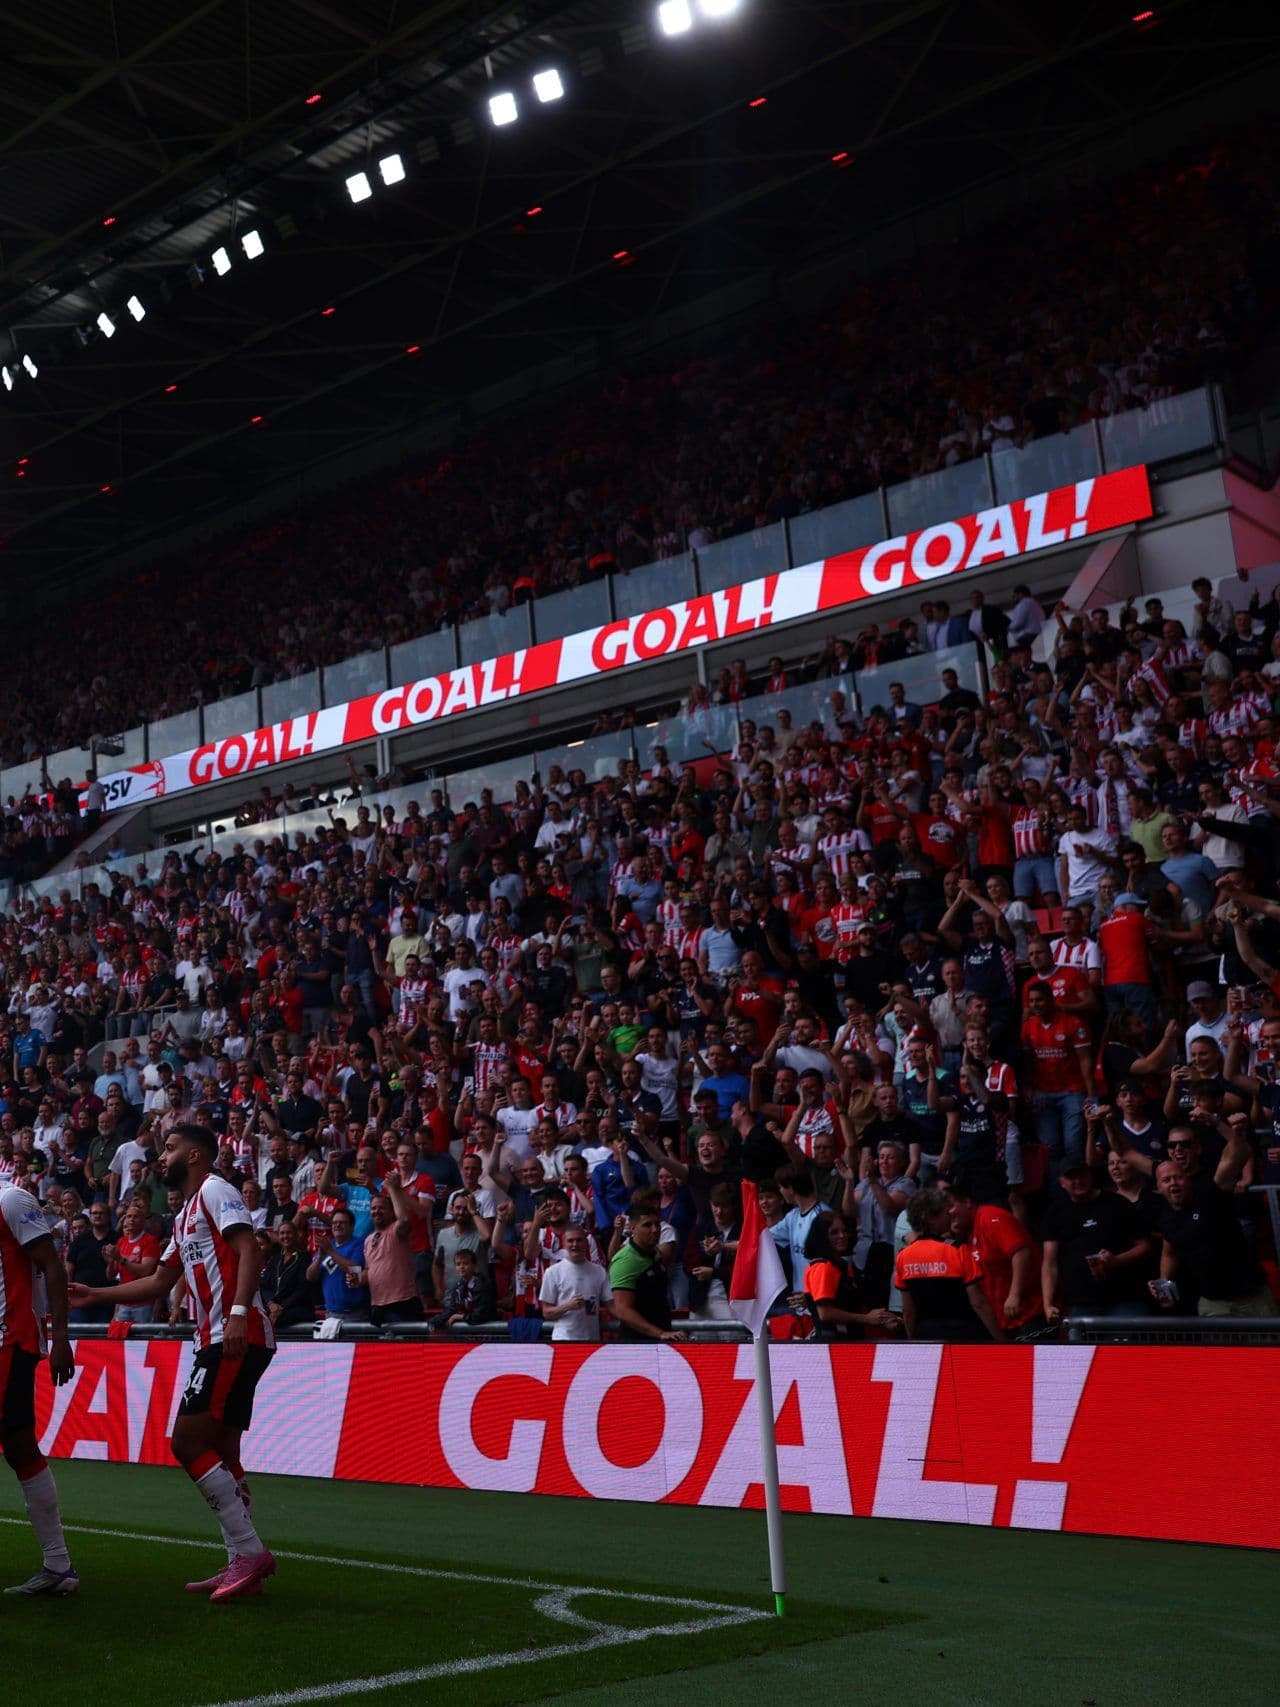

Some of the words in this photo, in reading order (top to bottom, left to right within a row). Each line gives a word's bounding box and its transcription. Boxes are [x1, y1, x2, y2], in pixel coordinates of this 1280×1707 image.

[189, 712, 318, 785] GOAL!
[371, 648, 528, 734] GOAL!
[591, 573, 781, 671] GOAL!
[859, 477, 1096, 596] GOAL!
[903, 1261, 948, 1276] STEWARD
[437, 1343, 1096, 1532] GOAL!
